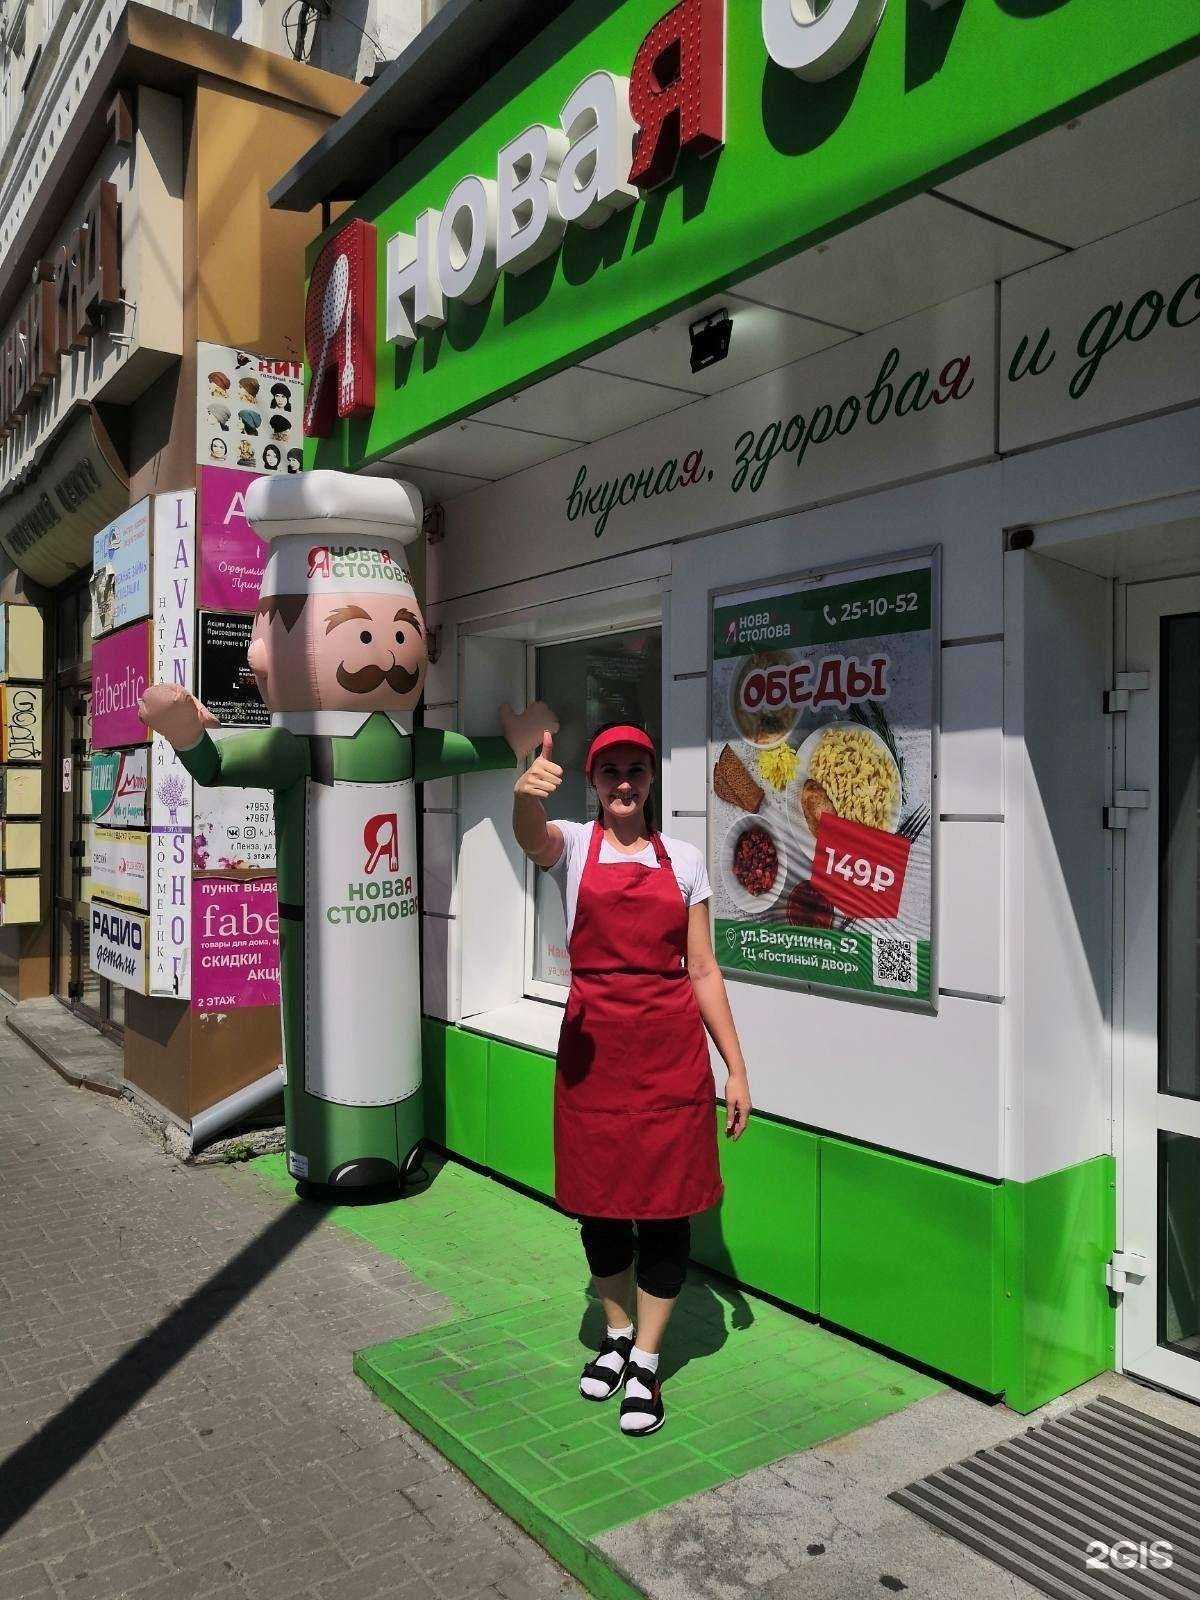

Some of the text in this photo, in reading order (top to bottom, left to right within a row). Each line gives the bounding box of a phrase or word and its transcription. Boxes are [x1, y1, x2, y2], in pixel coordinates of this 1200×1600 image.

[731, 347, 975, 494] здоровая
[1008, 326, 1056, 382] и
[840, 592, 919, 622] 25-10-52
[95, 664, 145, 716] faberlic
[743, 658, 887, 708] ОБЕДЫ
[245, 802, 269, 811] +7953
[245, 813, 269, 823] +7967
[202, 884, 240, 896] пункт
[348, 876, 412, 901] новая
[92, 910, 142, 950] РАДИО
[202, 903, 279, 938] fabe
[740, 929, 859, 954] ул.Бакунина, 52
[741, 947, 756, 961] ТЦ
[96, 944, 137, 976] детали
[201, 953, 262, 968] СКИДКИ!
[198, 996, 236, 1007] 2 ЭТАЖ
